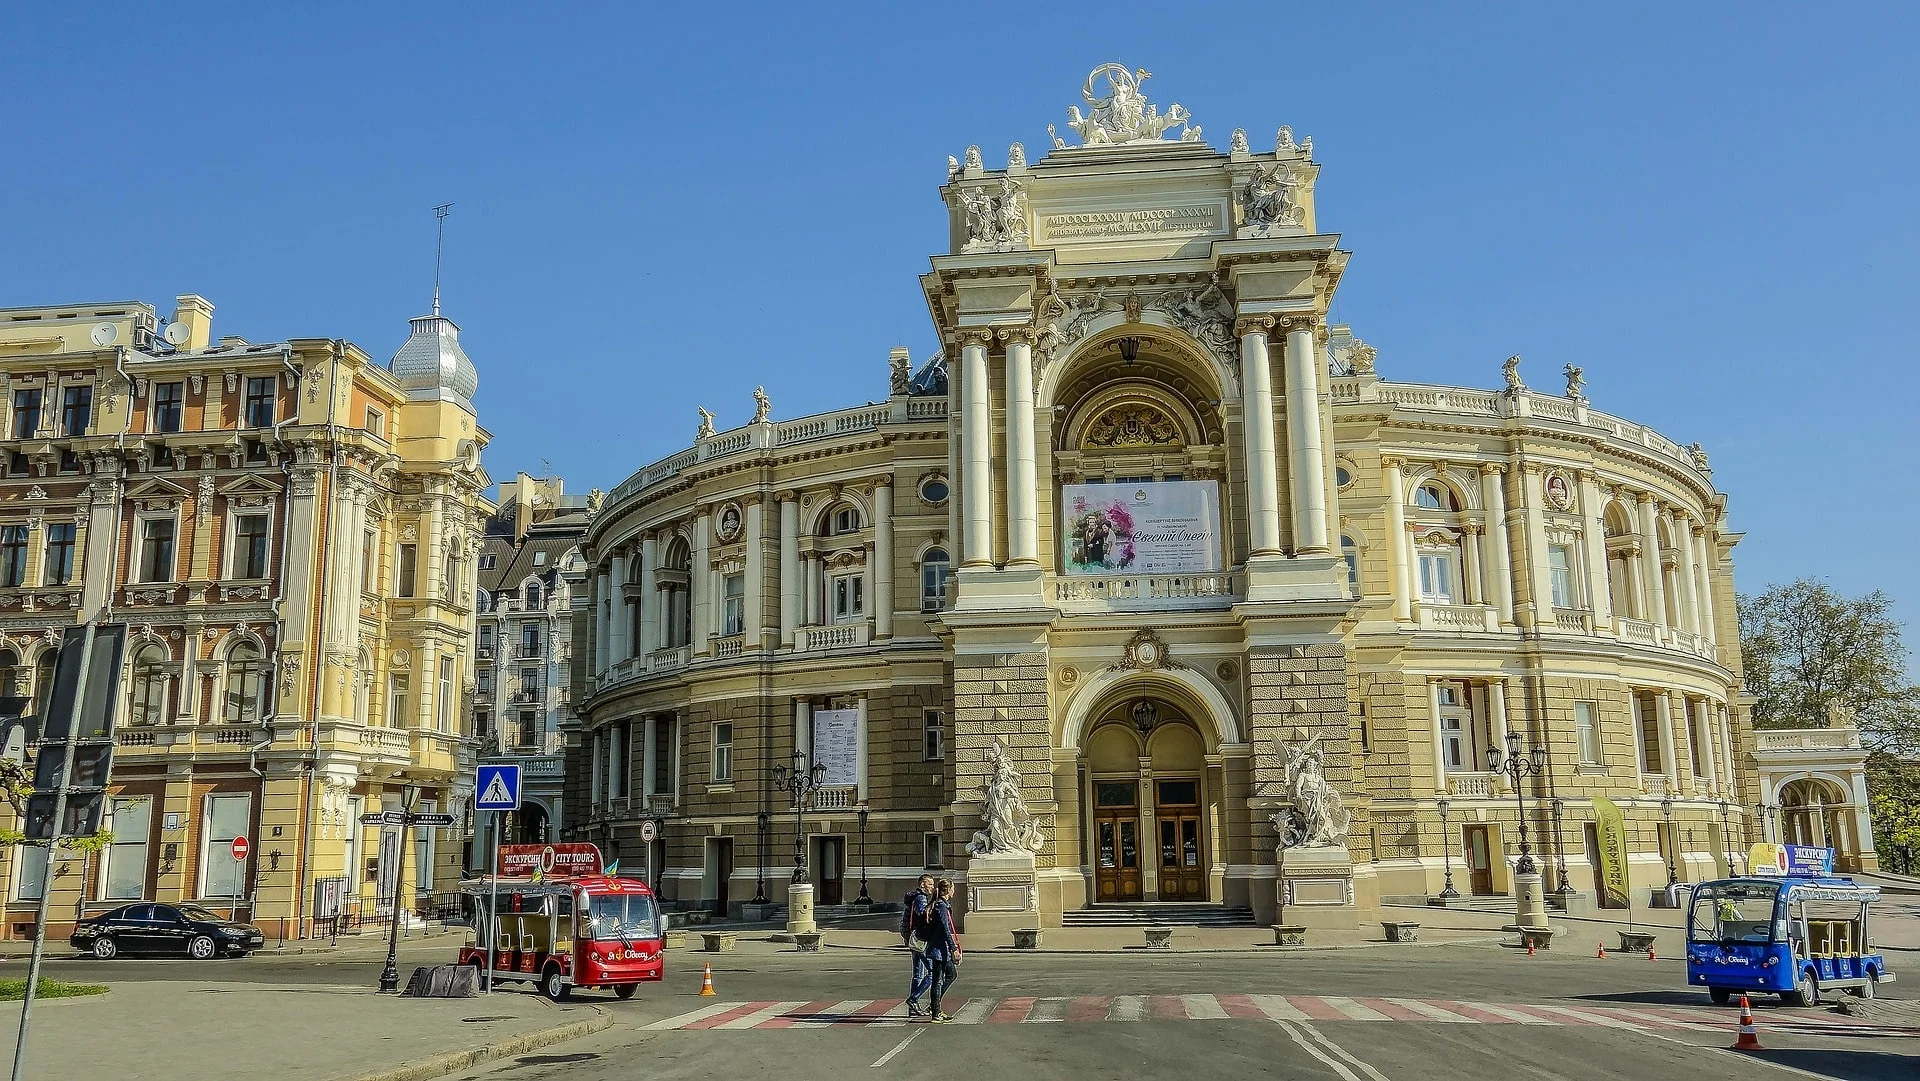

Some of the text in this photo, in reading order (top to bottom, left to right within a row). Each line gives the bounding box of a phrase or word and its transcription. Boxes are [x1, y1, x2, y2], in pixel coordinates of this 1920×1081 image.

[504, 854, 541, 864] ЭКСКУРСИИ
[555, 853, 595, 863] CITY TOURS
